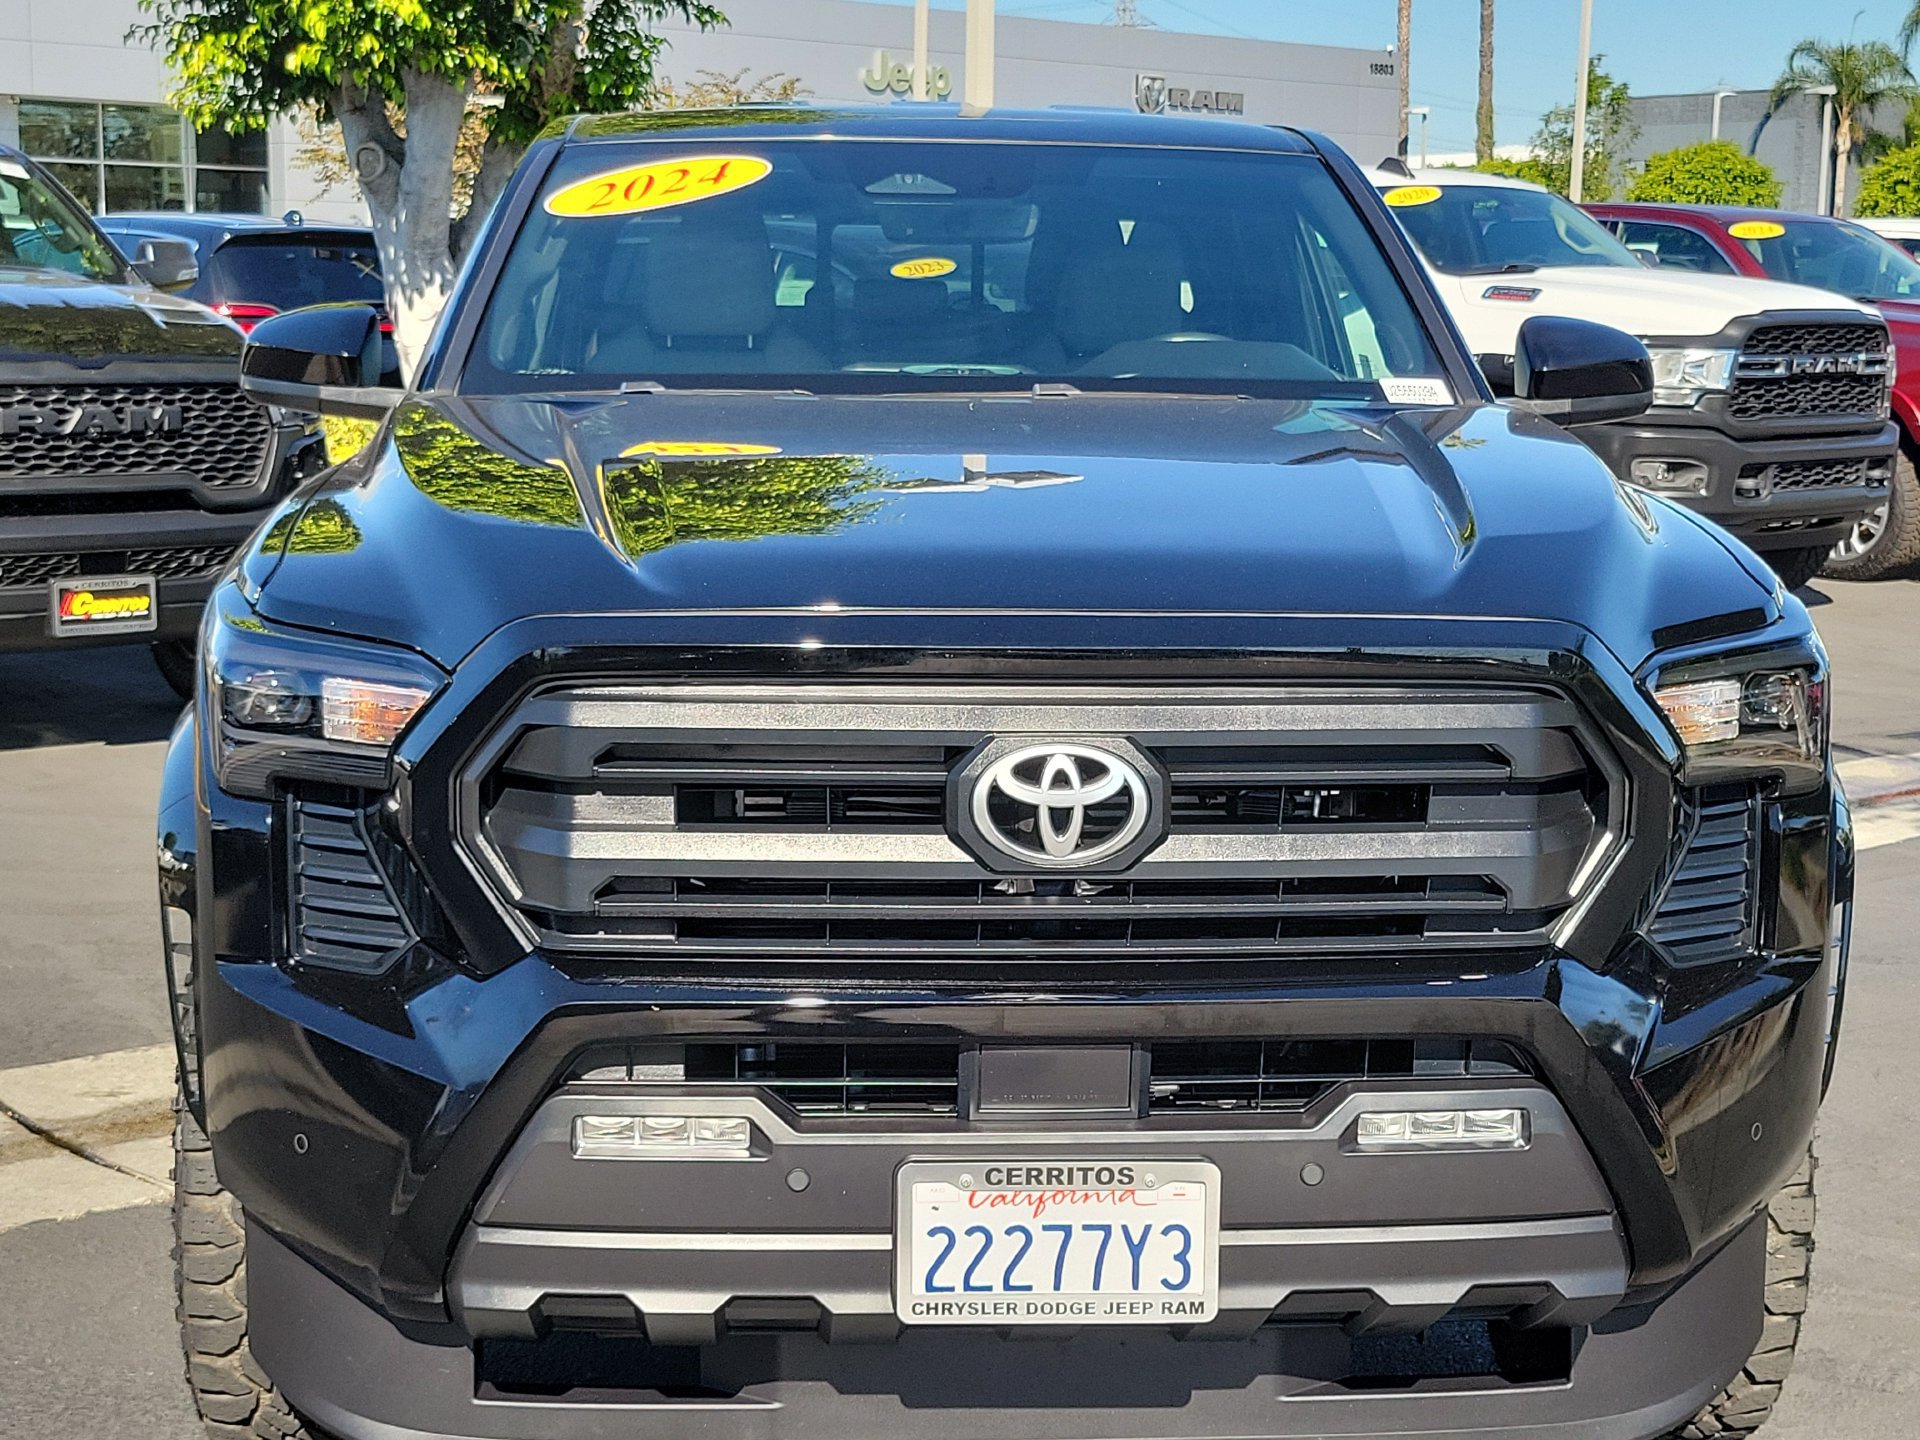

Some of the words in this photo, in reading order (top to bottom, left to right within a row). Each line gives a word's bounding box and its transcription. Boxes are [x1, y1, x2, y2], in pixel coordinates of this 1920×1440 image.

[1168, 88, 1243, 111] RAM
[585, 160, 732, 212] 2024
[903, 261, 945, 276] 2023
[1792, 357, 1859, 374] RAM
[1, 405, 184, 436] RAM
[984, 1166, 1135, 1186] CERRITOS
[967, 1189, 1158, 1219] California
[925, 1223, 1192, 1292] 22277Y3
[911, 1301, 1018, 1316] CHRYSLER
[1025, 1301, 1096, 1316] DODGE
[1103, 1301, 1154, 1316] JEEP
[1161, 1300, 1205, 1315] RAM
